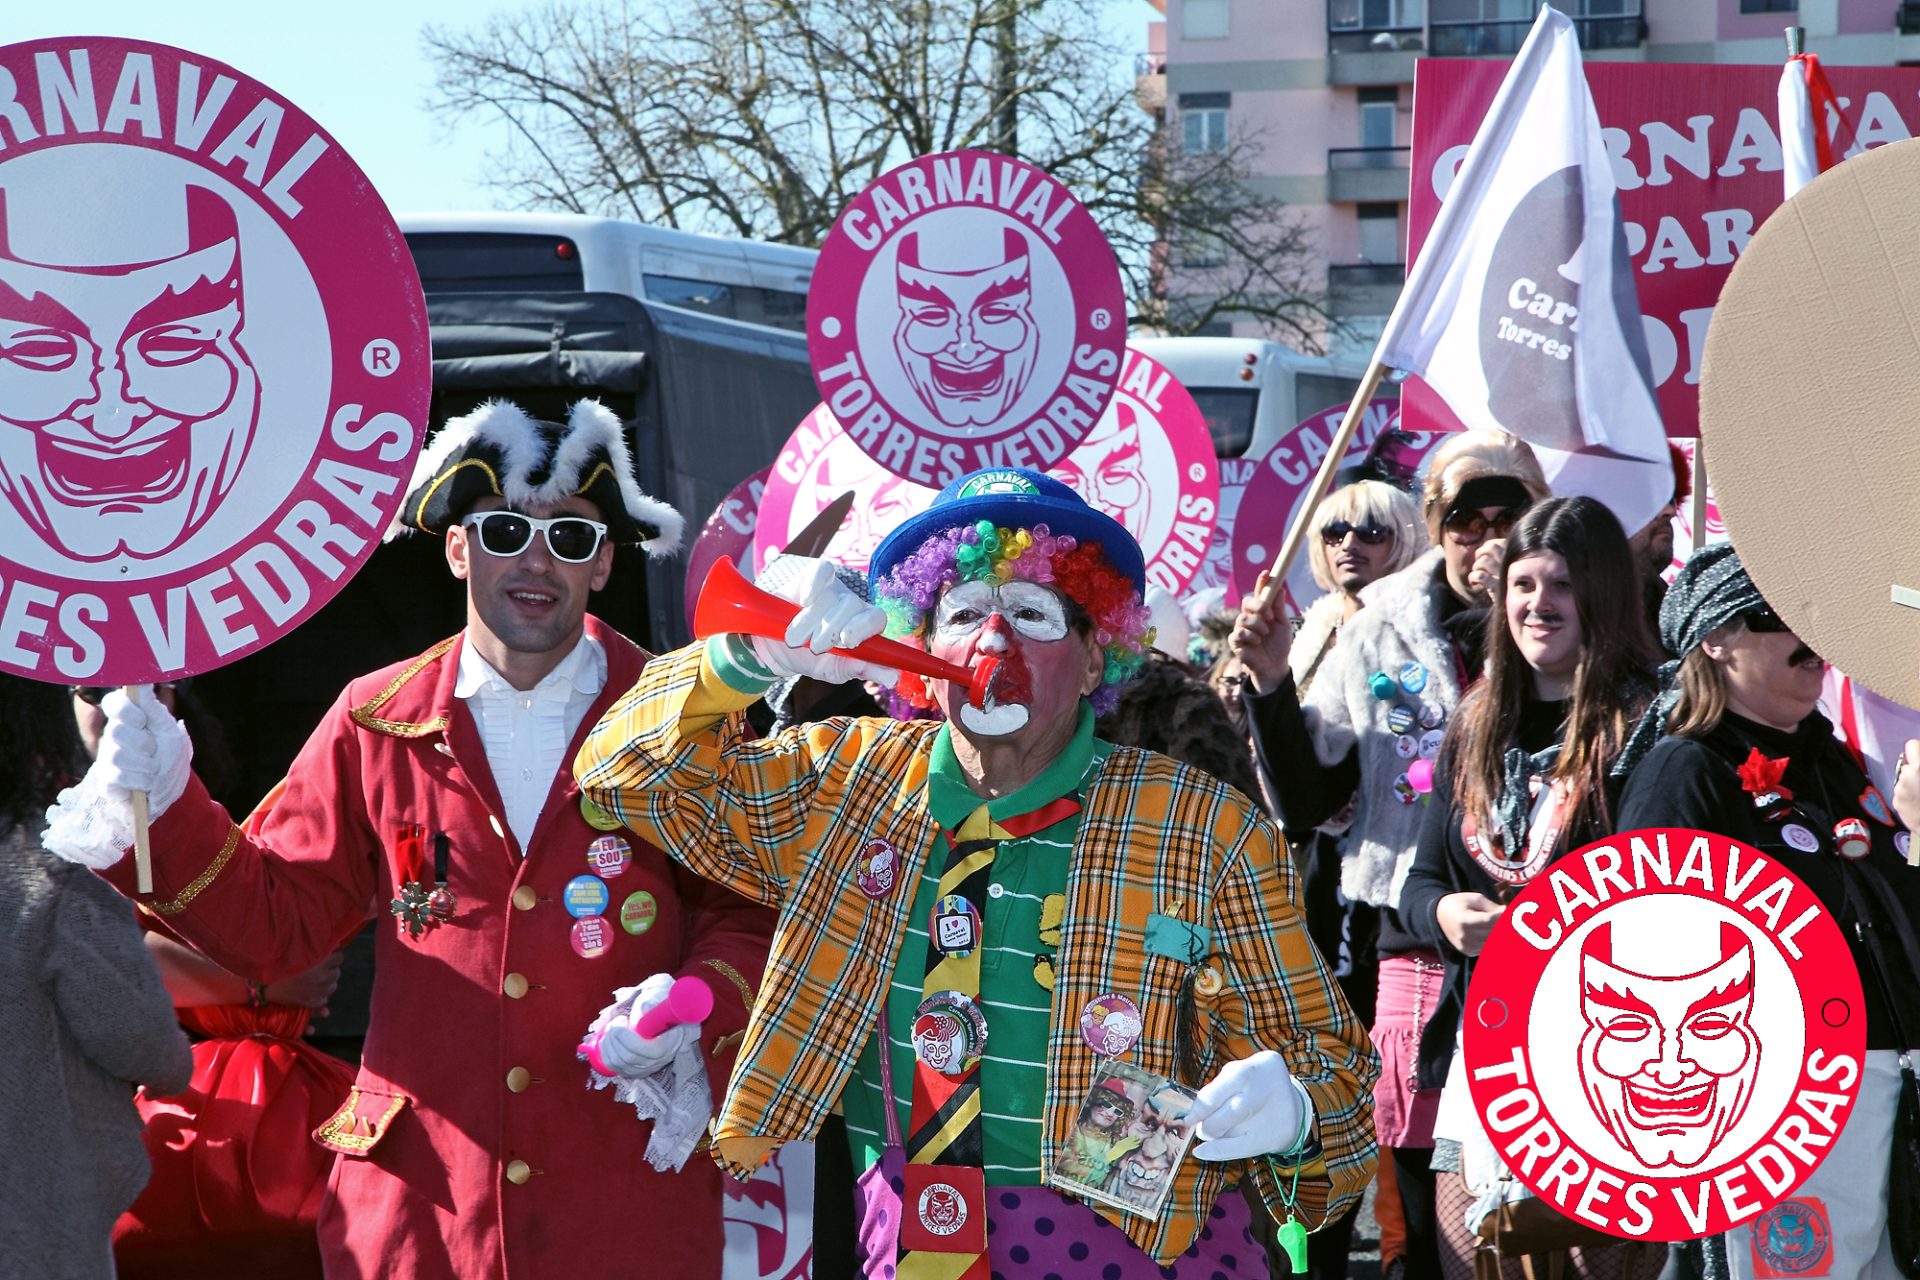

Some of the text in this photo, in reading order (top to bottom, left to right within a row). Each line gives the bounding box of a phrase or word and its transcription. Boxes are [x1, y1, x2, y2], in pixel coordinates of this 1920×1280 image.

[841, 157, 1075, 251] CARNAVAL
[1497, 316, 1572, 360] Torres
[819, 343, 1119, 488] TORRES VEDRAS
[971, 471, 1032, 491] CARNAVAL
[0, 403, 415, 678] ES VEDRAS
[602, 839, 615, 851] EU
[599, 850, 621, 865] SOU
[923, 1184, 961, 1201] CARNAVAL
[941, 1211, 966, 1234] VEDRAS
